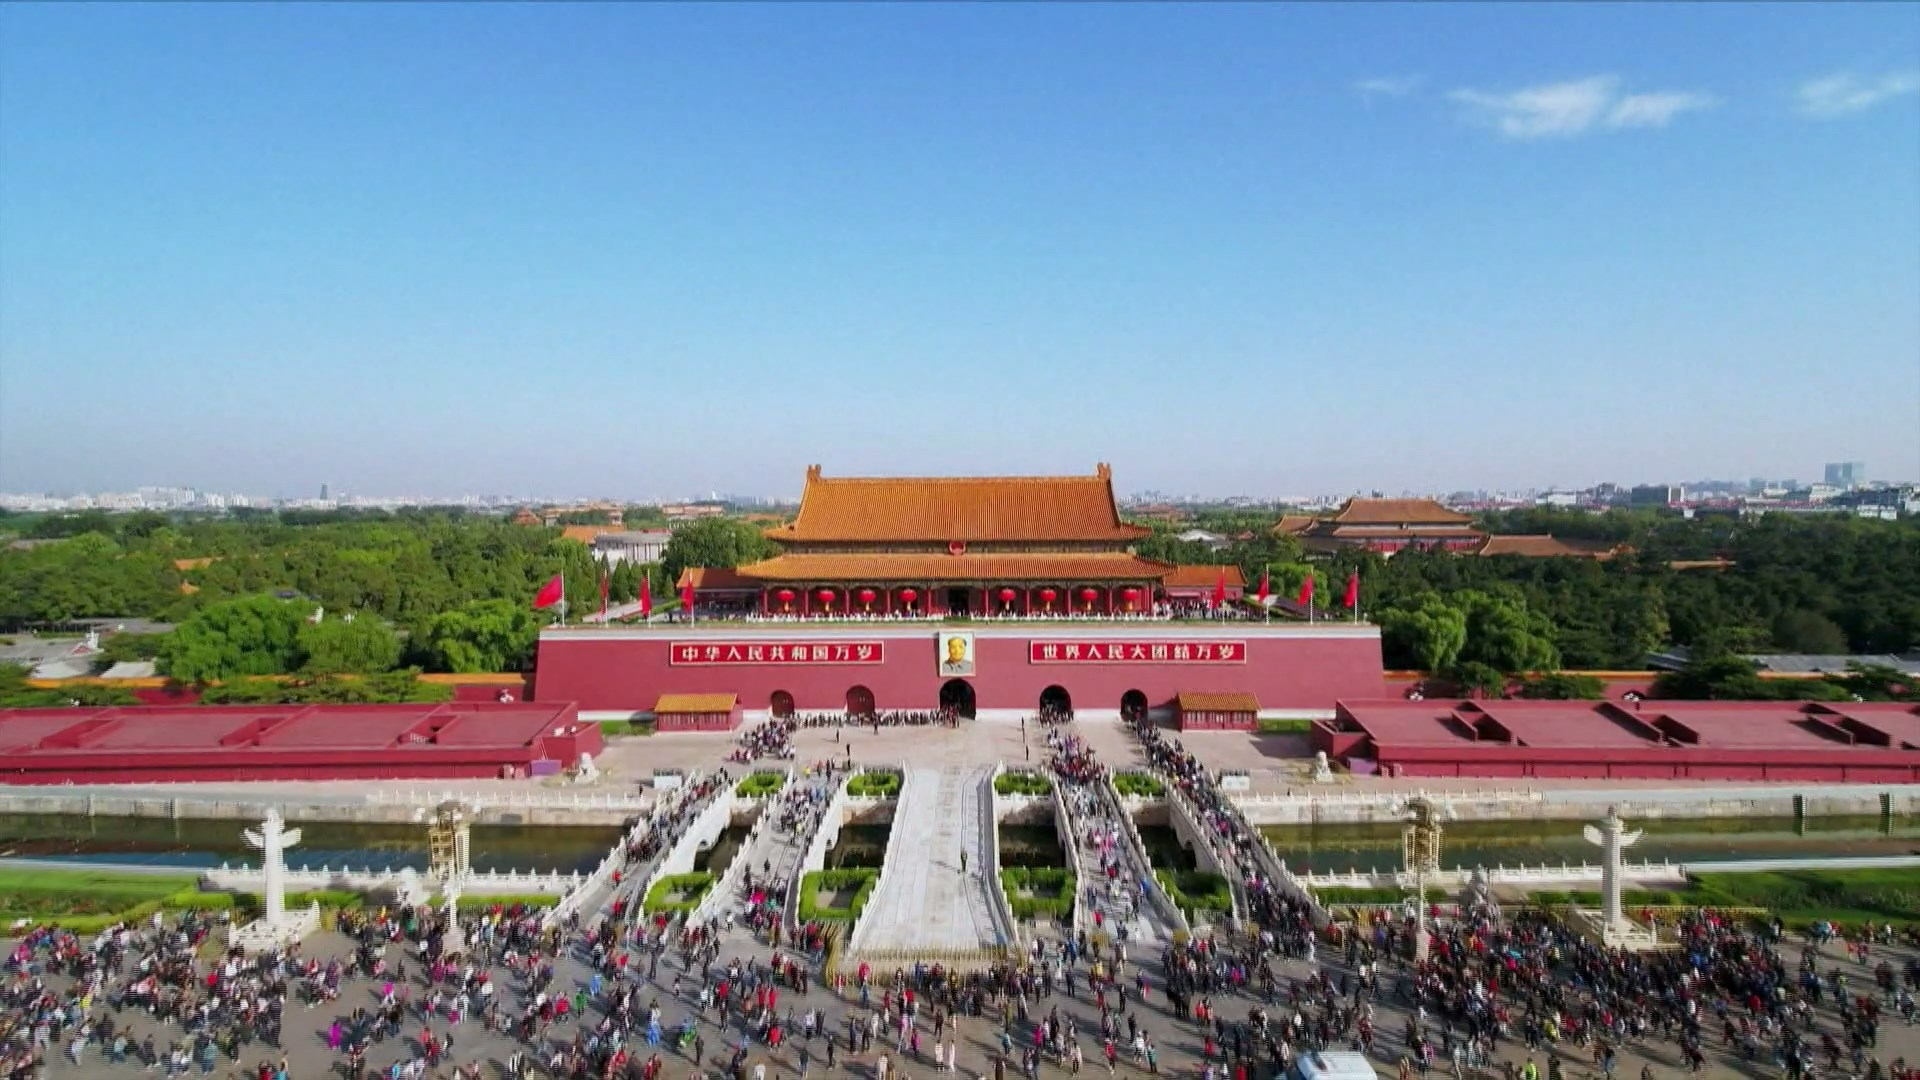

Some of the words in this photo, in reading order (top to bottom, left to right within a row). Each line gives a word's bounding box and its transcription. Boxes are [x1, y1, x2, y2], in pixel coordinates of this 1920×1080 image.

[682, 646, 872, 661] 中华人民共和国万岁
